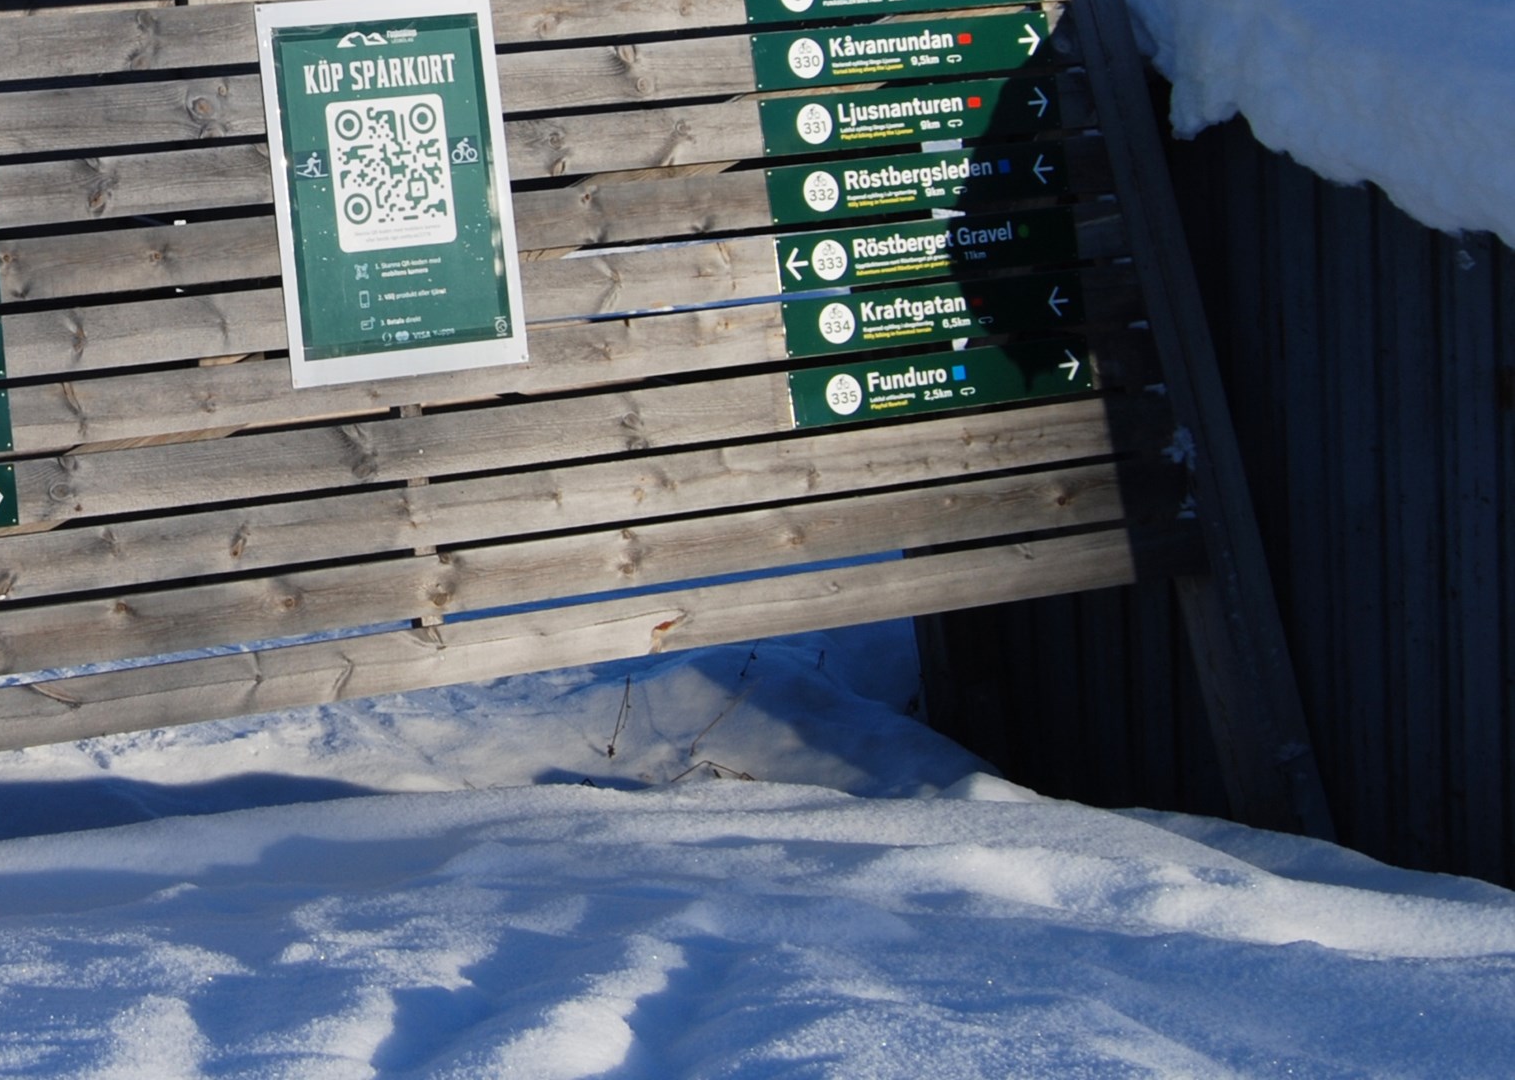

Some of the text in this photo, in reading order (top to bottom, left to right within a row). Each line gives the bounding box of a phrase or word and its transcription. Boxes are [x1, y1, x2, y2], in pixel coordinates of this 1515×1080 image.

[828, 29, 954, 57] Kåvanrundan
[793, 55, 821, 69] 330
[910, 55, 940, 66] 9,5km
[303, 52, 455, 95] KÖP SPÅRKORT
[837, 96, 963, 126] Ljusnanturen
[803, 121, 827, 135] 331
[920, 120, 940, 130] 9km
[844, 158, 992, 190] Röstbergsleden
[808, 188, 835, 201] 332
[925, 187, 946, 198] 9km
[852, 221, 1013, 258] Röstberget Gravel
[964, 250, 986, 260] 11km
[817, 257, 844, 270] 333
[860, 296, 967, 322] Kraftgatan
[824, 320, 851, 334] 334
[942, 317, 971, 329] 6,5km
[867, 366, 947, 392] Funduro
[831, 390, 858, 404] 335
[924, 388, 953, 401] 2,5km
